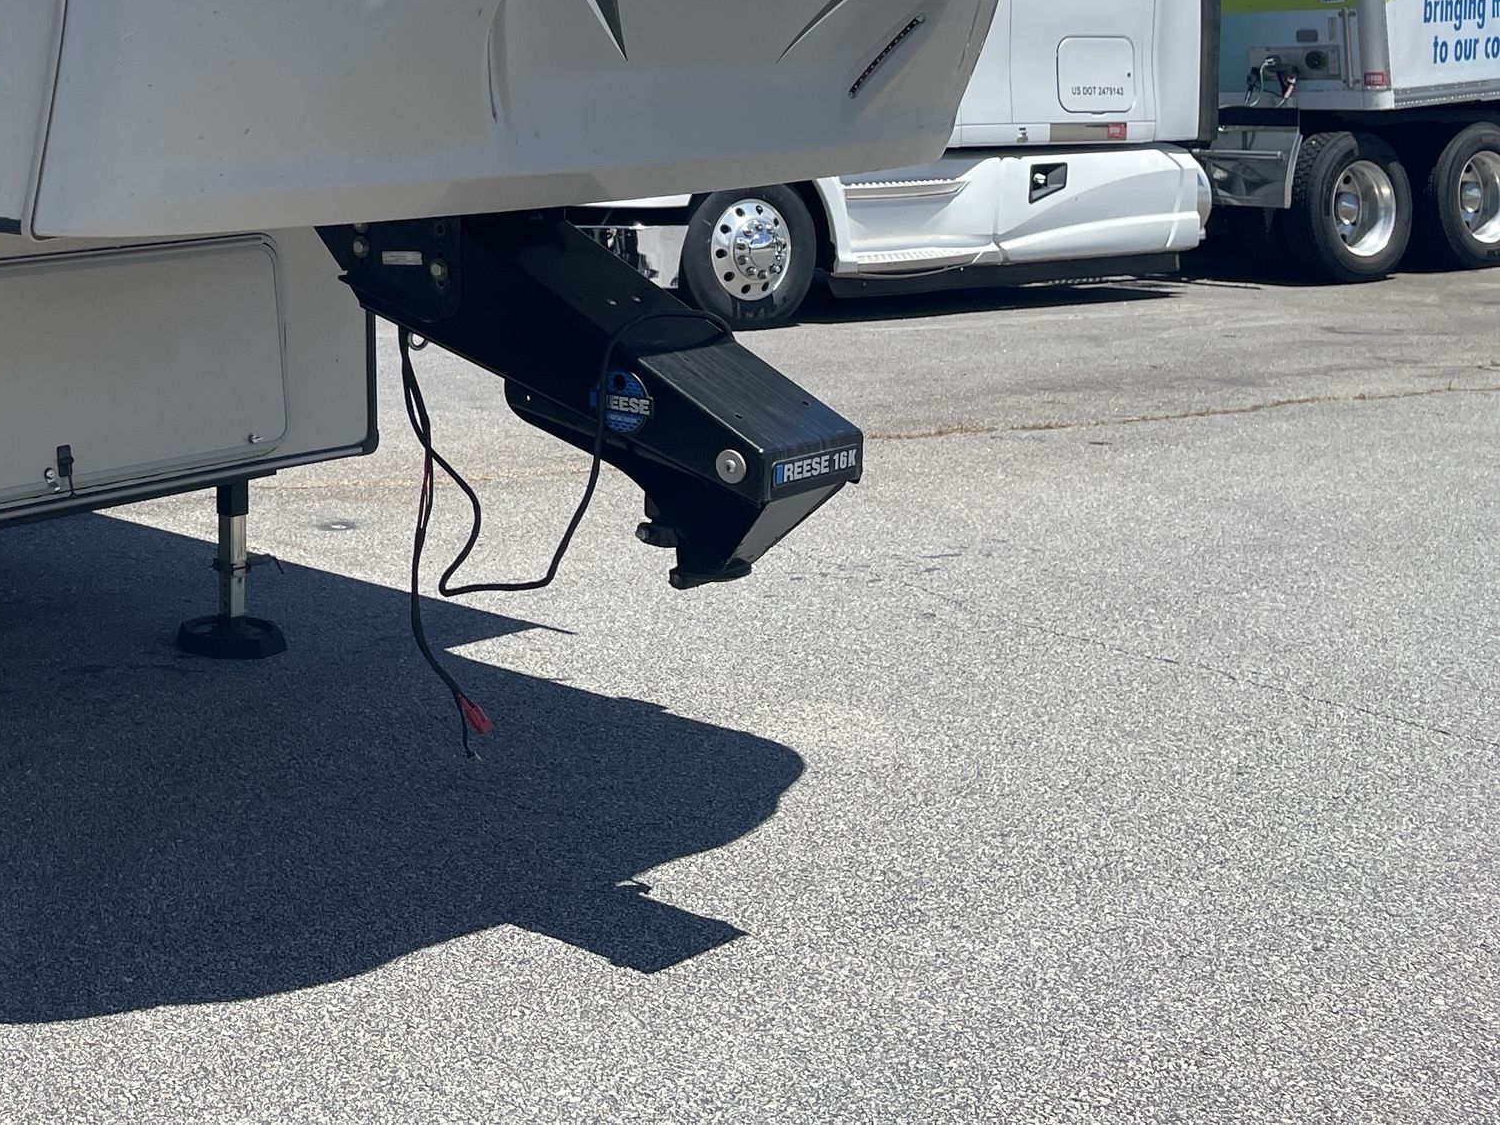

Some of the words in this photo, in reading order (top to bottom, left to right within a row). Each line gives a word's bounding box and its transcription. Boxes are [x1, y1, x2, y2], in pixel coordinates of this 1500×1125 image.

[1433, 35, 1448, 64] to
[1454, 38, 1479, 62] our
[1485, 36, 1500, 59] co
[1071, 86, 1081, 96] US
[1082, 86, 1097, 96] DOT
[783, 455, 830, 482] REESE
[833, 449, 857, 470] 16K
